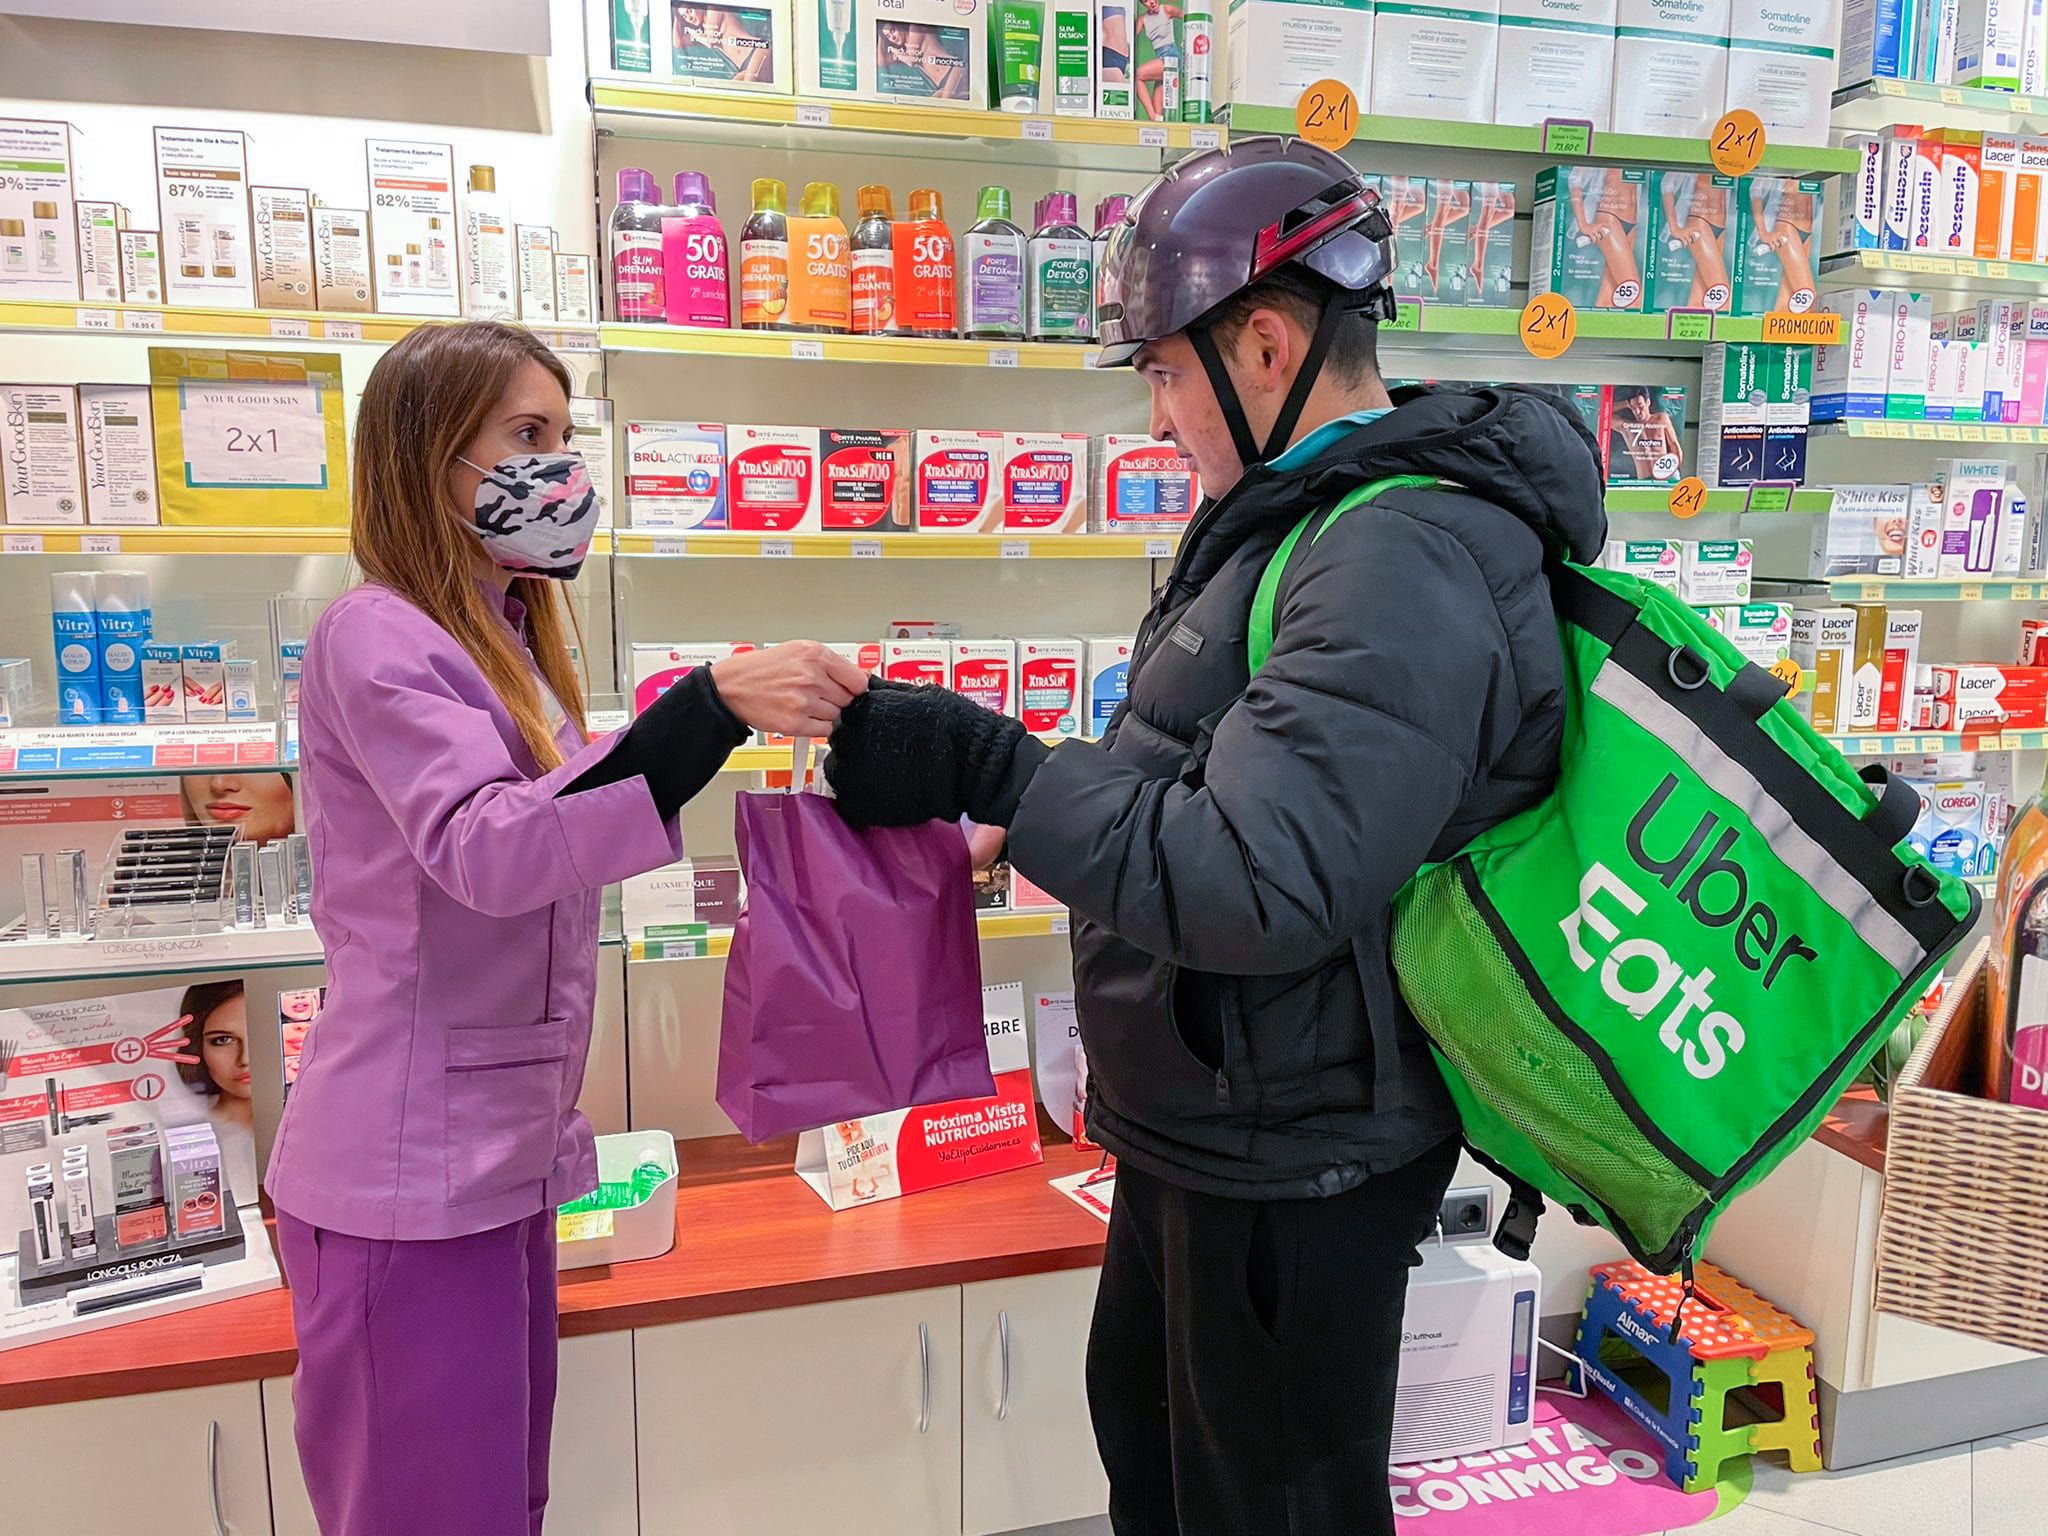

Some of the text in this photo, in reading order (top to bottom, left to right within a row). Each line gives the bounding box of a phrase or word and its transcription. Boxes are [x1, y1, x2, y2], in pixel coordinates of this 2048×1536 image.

[1660, 10, 1696, 22] Cosmetic
[1761, 9, 1811, 25] Somatoline
[1059, 25, 1075, 33] SLIM
[1768, 22, 1802, 34] Cosmetic
[1305, 93, 1349, 131] 2x1
[1716, 121, 1759, 158] 2x1
[1986, 137, 2016, 149] Sensi
[1985, 149, 2015, 162] Lacer
[168, 184, 204, 198] 87%
[376, 194, 410, 208] 82%
[687, 265, 726, 281] GRATIS
[807, 263, 848, 279] GRATIS
[913, 264, 952, 279] GRATIS
[1526, 304, 1569, 340] 2x1
[1769, 316, 1834, 337] PROMOCIÓN
[1737, 346, 1749, 400] Somatoline
[1781, 346, 1792, 400] Somatoline
[203, 394, 299, 405] YOUR GOOD SKIN
[226, 427, 280, 453] 2x1
[876, 452, 892, 460] MEN
[1672, 485, 1704, 507] 2x1
[1878, 490, 1905, 503] Kiss
[57, 619, 92, 632] Vitry
[101, 618, 135, 632] Vitry
[1791, 618, 1816, 629] acer
[1822, 617, 1854, 630] Lacer
[1890, 621, 1919, 633] Lacer
[1821, 630, 1847, 641] Oros
[147, 649, 173, 660] Vitry
[188, 648, 215, 660] Vitry
[1961, 676, 1996, 689] Lacer
[1854, 682, 1865, 718] Lacer
[1864, 688, 1873, 717] Oros
[1941, 796, 1978, 810] COREGA
[1624, 771, 1820, 992] Uber
[1558, 860, 1746, 1080] Eats
[923, 1101, 1026, 1133] Próxima Visita
[925, 1116, 1028, 1147] NUTRICIONISTA
[1617, 1311, 1650, 1345] Almax
[1390, 1449, 1660, 1517] CONMIGO
